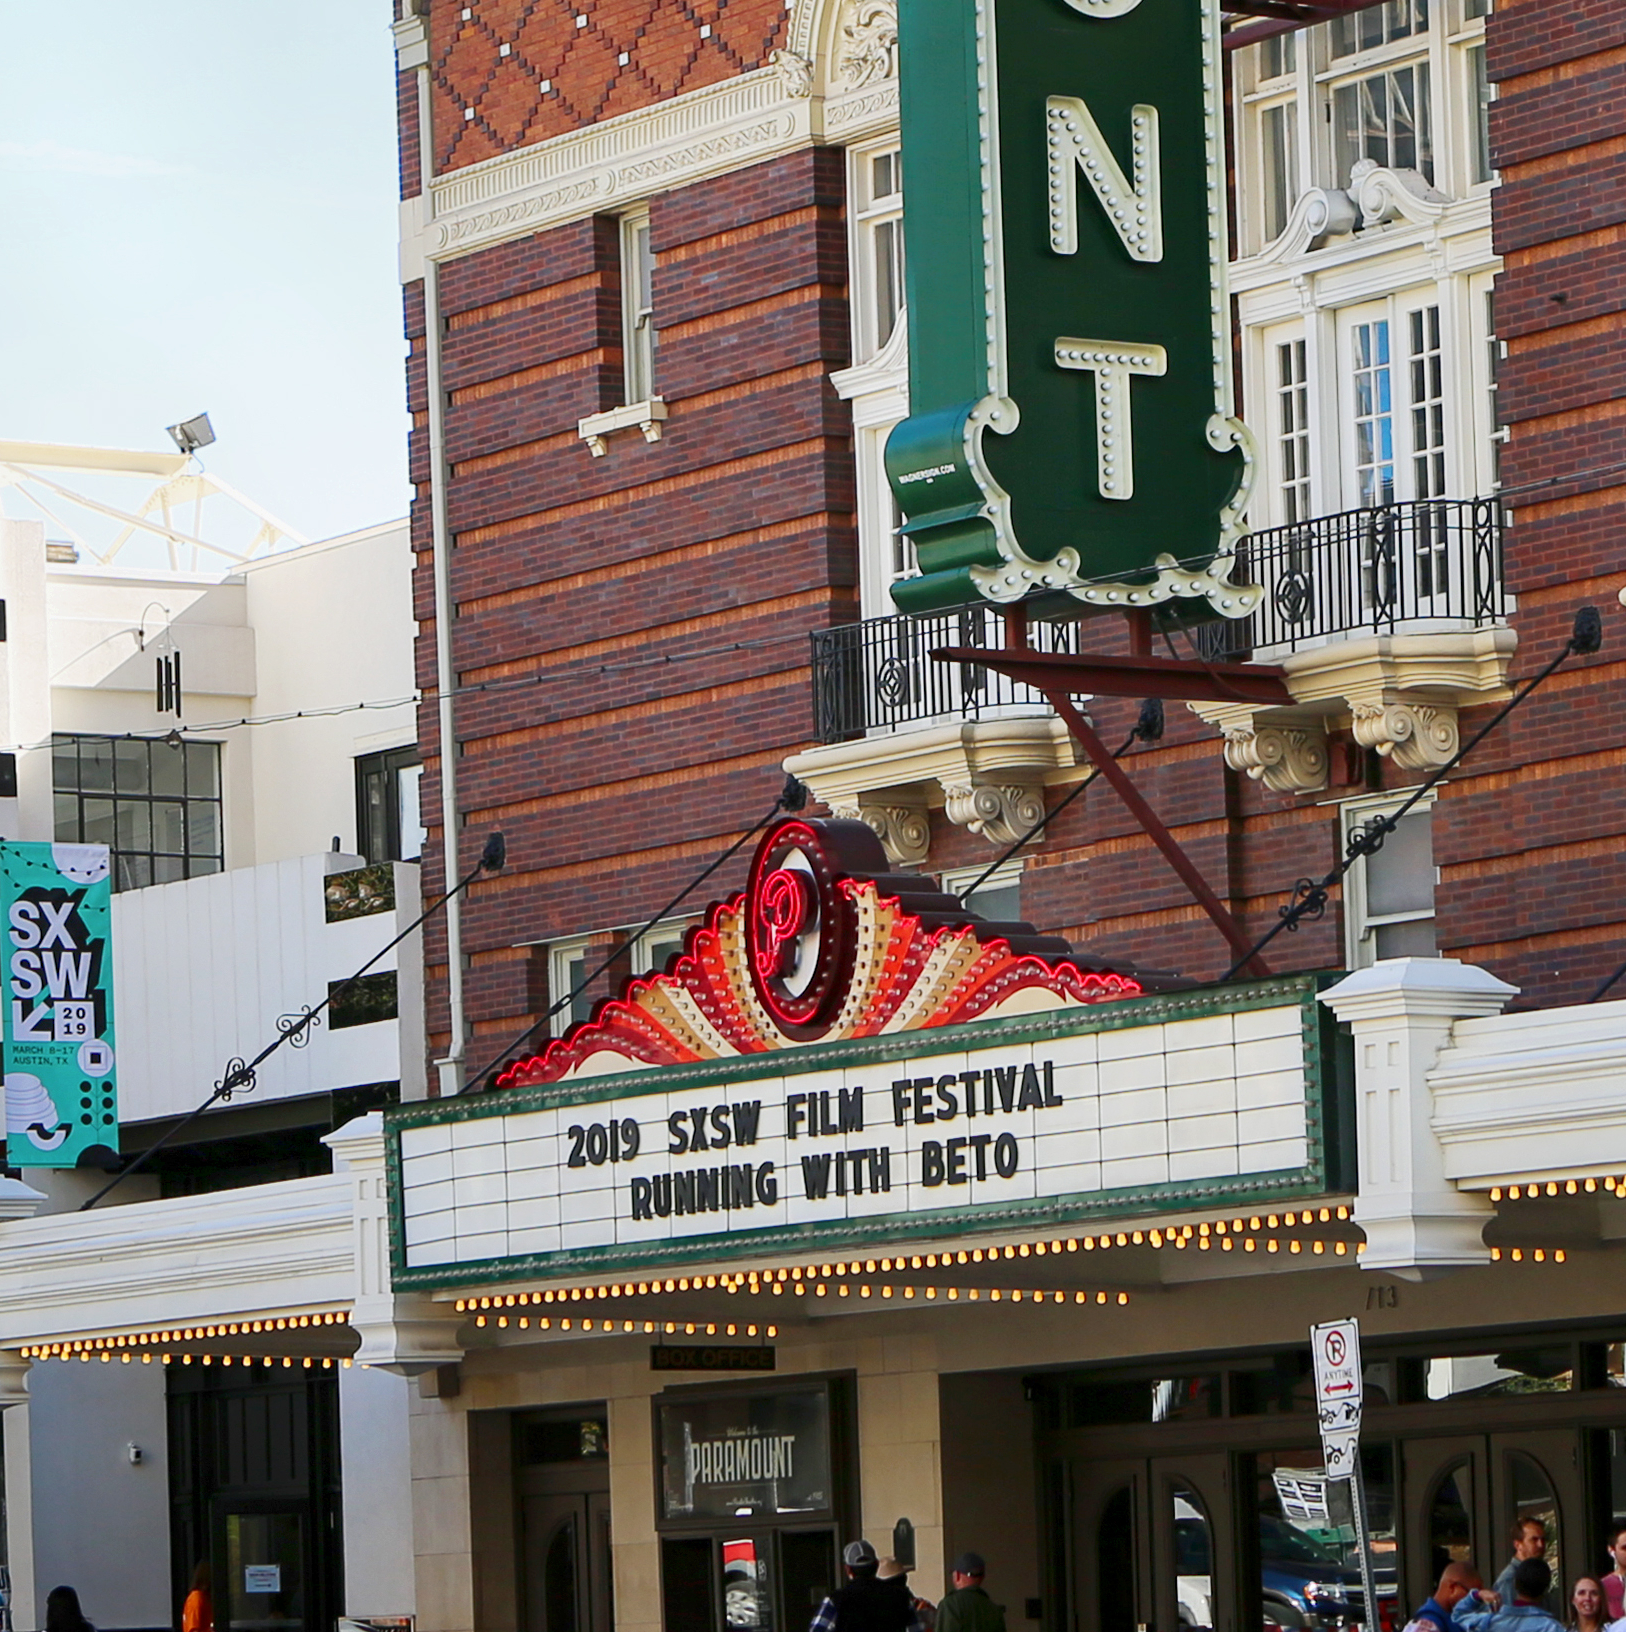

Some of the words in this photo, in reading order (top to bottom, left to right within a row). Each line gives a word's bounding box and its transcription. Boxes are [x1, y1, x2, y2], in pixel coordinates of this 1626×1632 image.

[62, 1007, 87, 1021] 20
[62, 1023, 87, 1037] 19
[12, 1045, 45, 1055] MARCH
[12, 1056, 53, 1066] AUSTIN,
[54, 1056, 69, 1066] TX
[567, 1118, 641, 1168] 2019
[667, 1099, 762, 1155] SXSW
[786, 1086, 864, 1140] FILM
[891, 1060, 1064, 1128] FESTIVAL
[630, 1160, 778, 1222] RUNNING
[800, 1146, 891, 1201] WITH
[921, 1131, 1019, 1188] BETO
[656, 1349, 696, 1367] BOX
[702, 1349, 772, 1367] OFFICE
[1323, 1367, 1354, 1381] ANYTIME
[689, 1434, 796, 1485] PARAMOUNT
